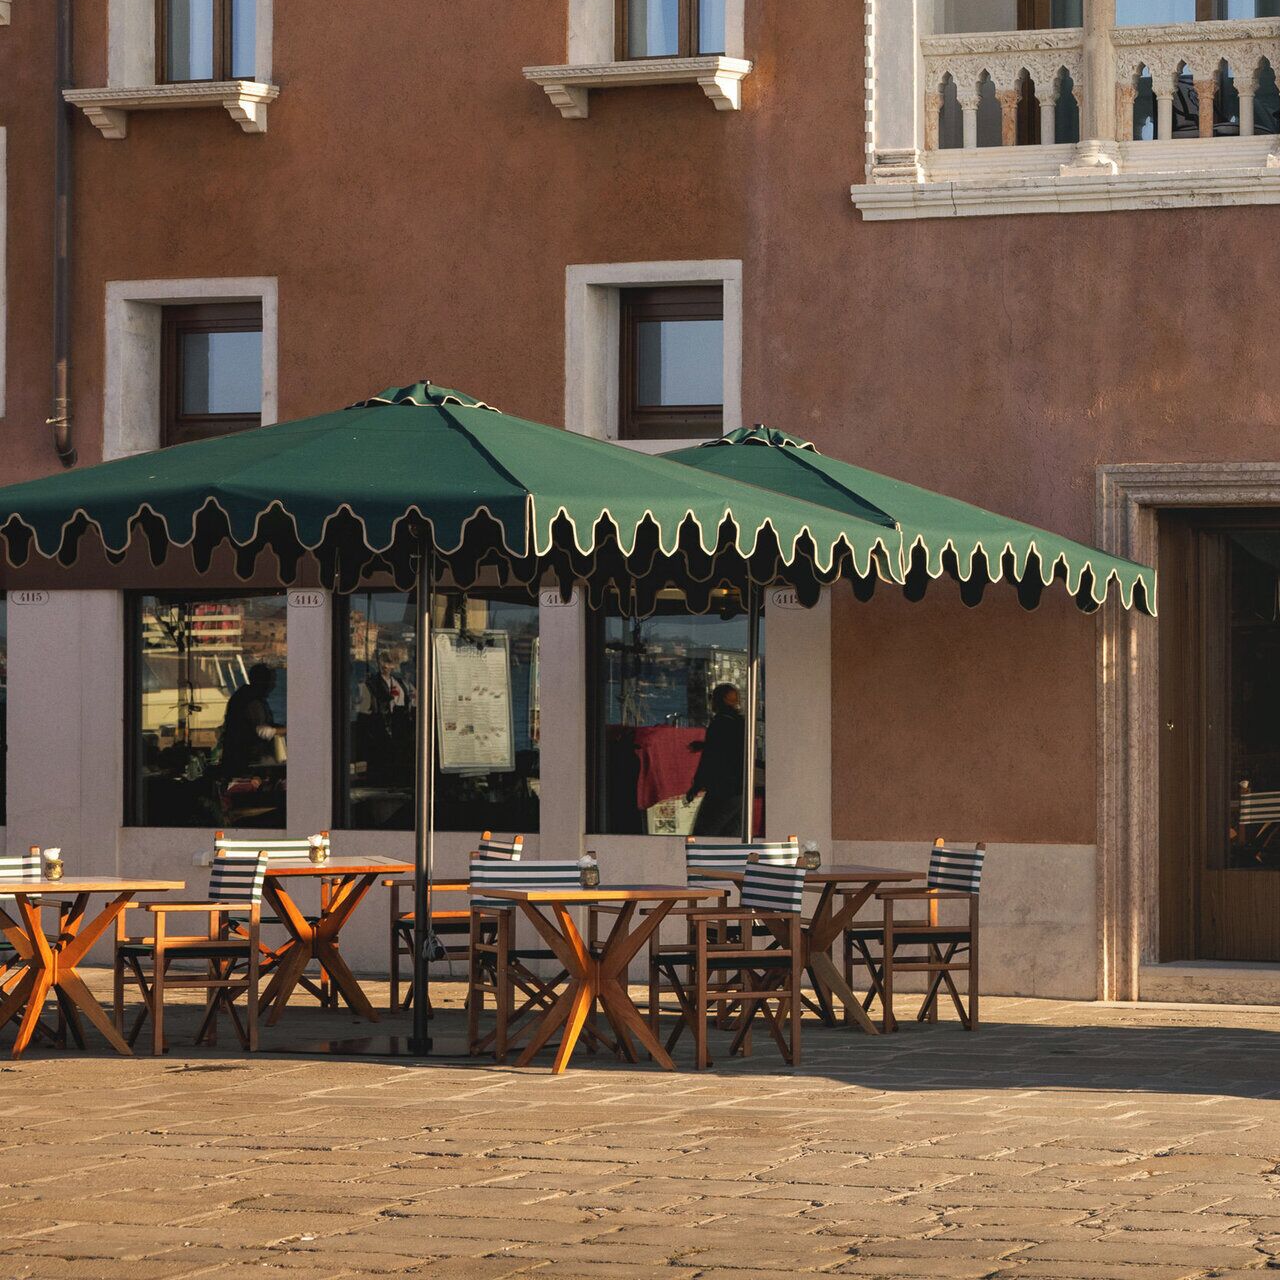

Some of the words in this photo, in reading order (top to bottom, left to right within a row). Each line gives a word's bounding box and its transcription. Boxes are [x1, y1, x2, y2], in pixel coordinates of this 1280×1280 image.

[20, 592, 42, 602] 4115
[295, 595, 318, 605] 4114
[776, 594, 800, 604] 411
